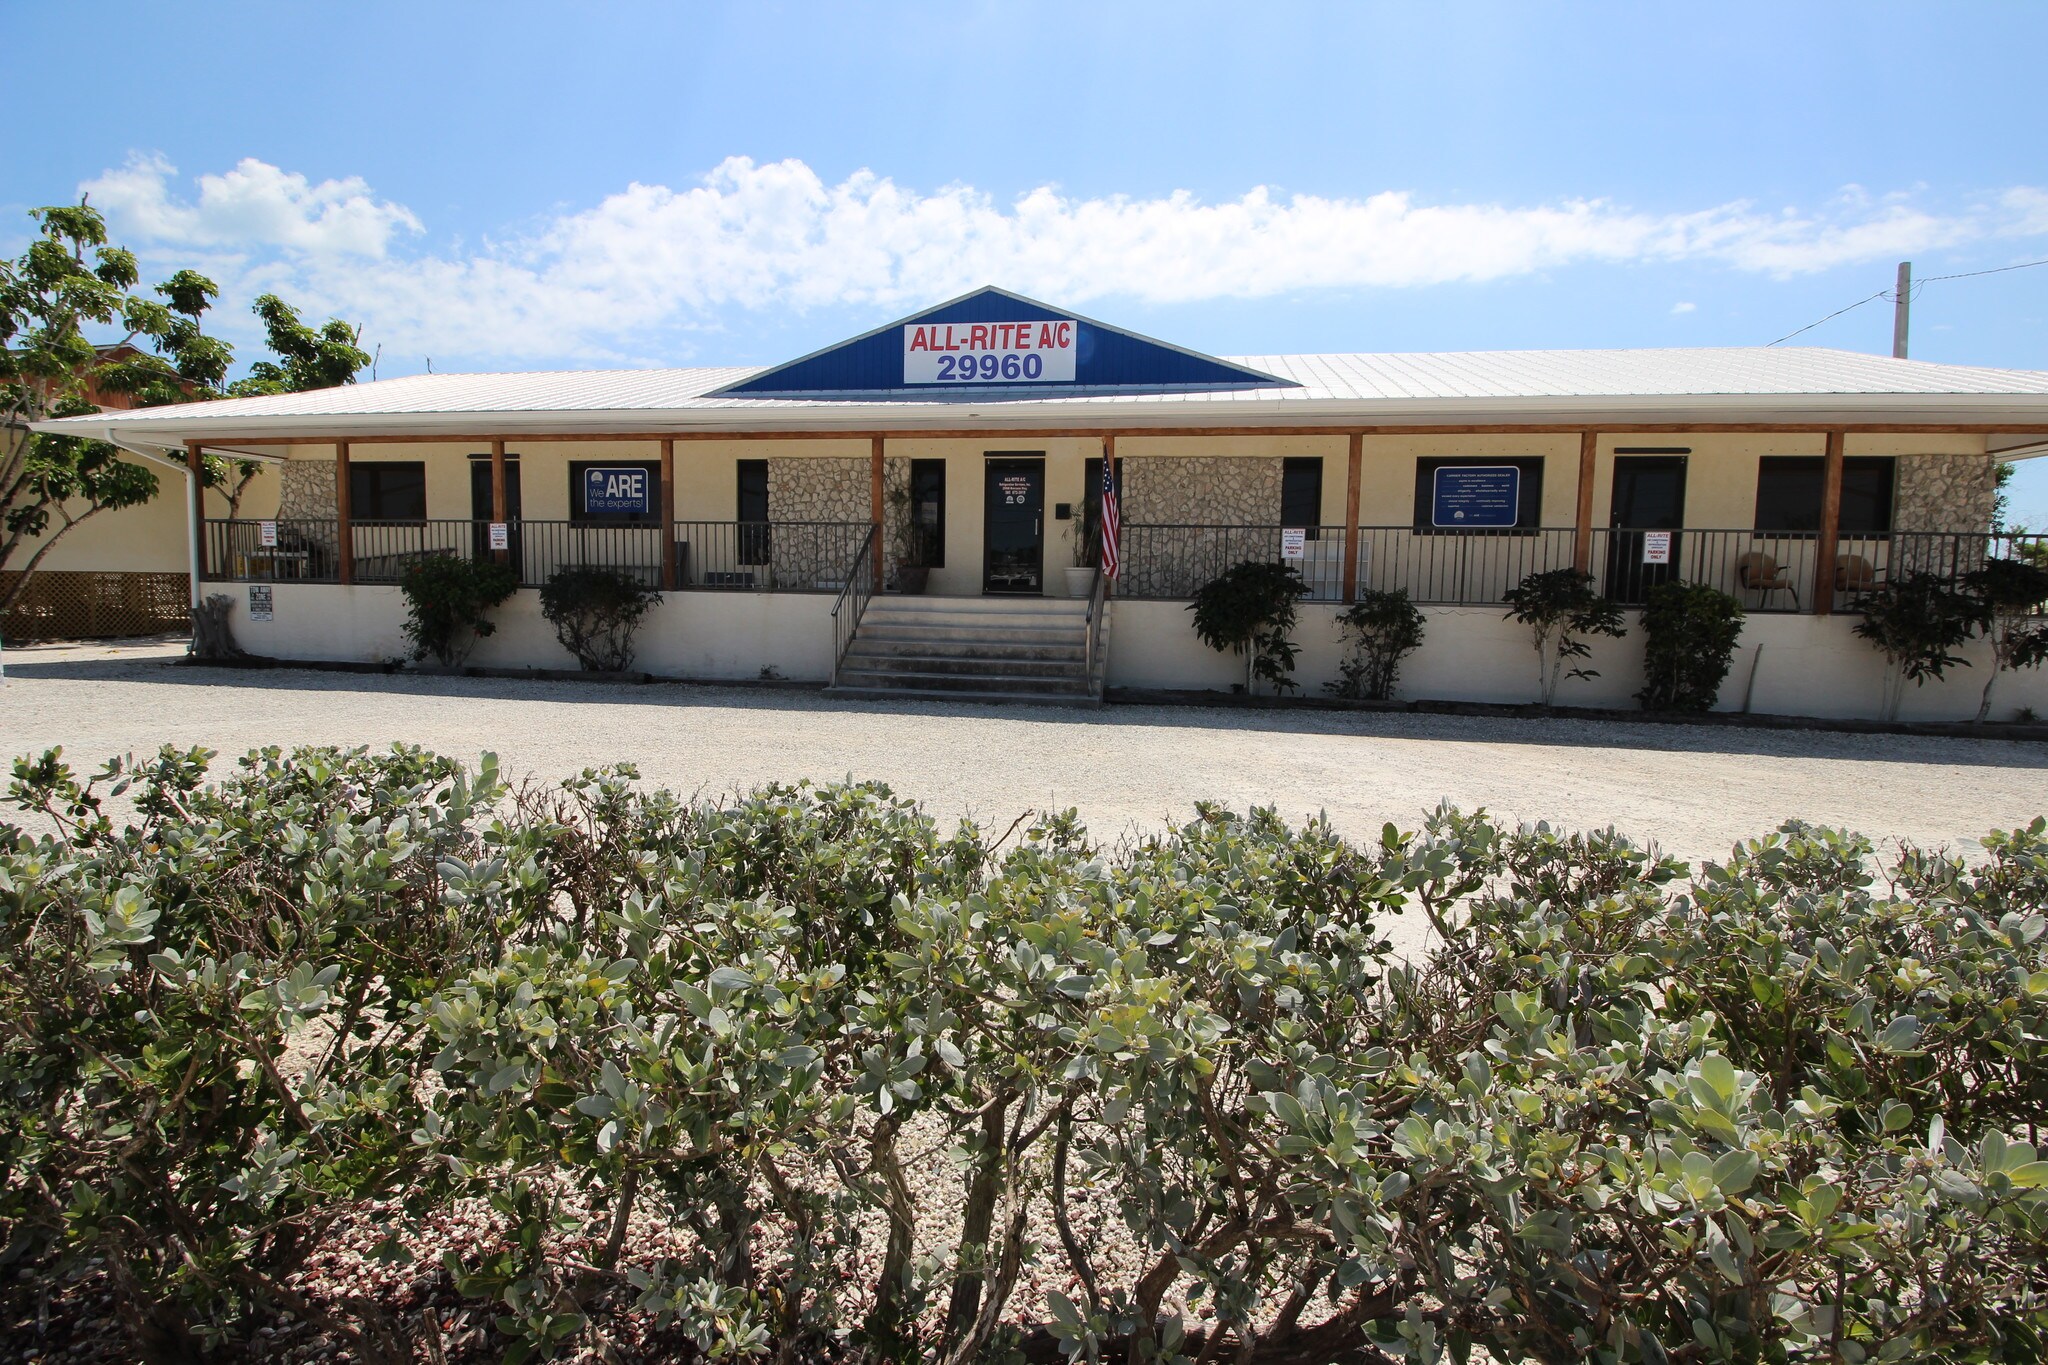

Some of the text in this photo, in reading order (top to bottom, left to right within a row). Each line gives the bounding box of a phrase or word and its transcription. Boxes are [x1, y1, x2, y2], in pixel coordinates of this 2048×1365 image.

[909, 322, 1071, 352] ALL-RITE A/C
[936, 353, 1043, 381] 29960
[590, 475, 643, 498] We ARE
[590, 498, 643, 510] the experts!
